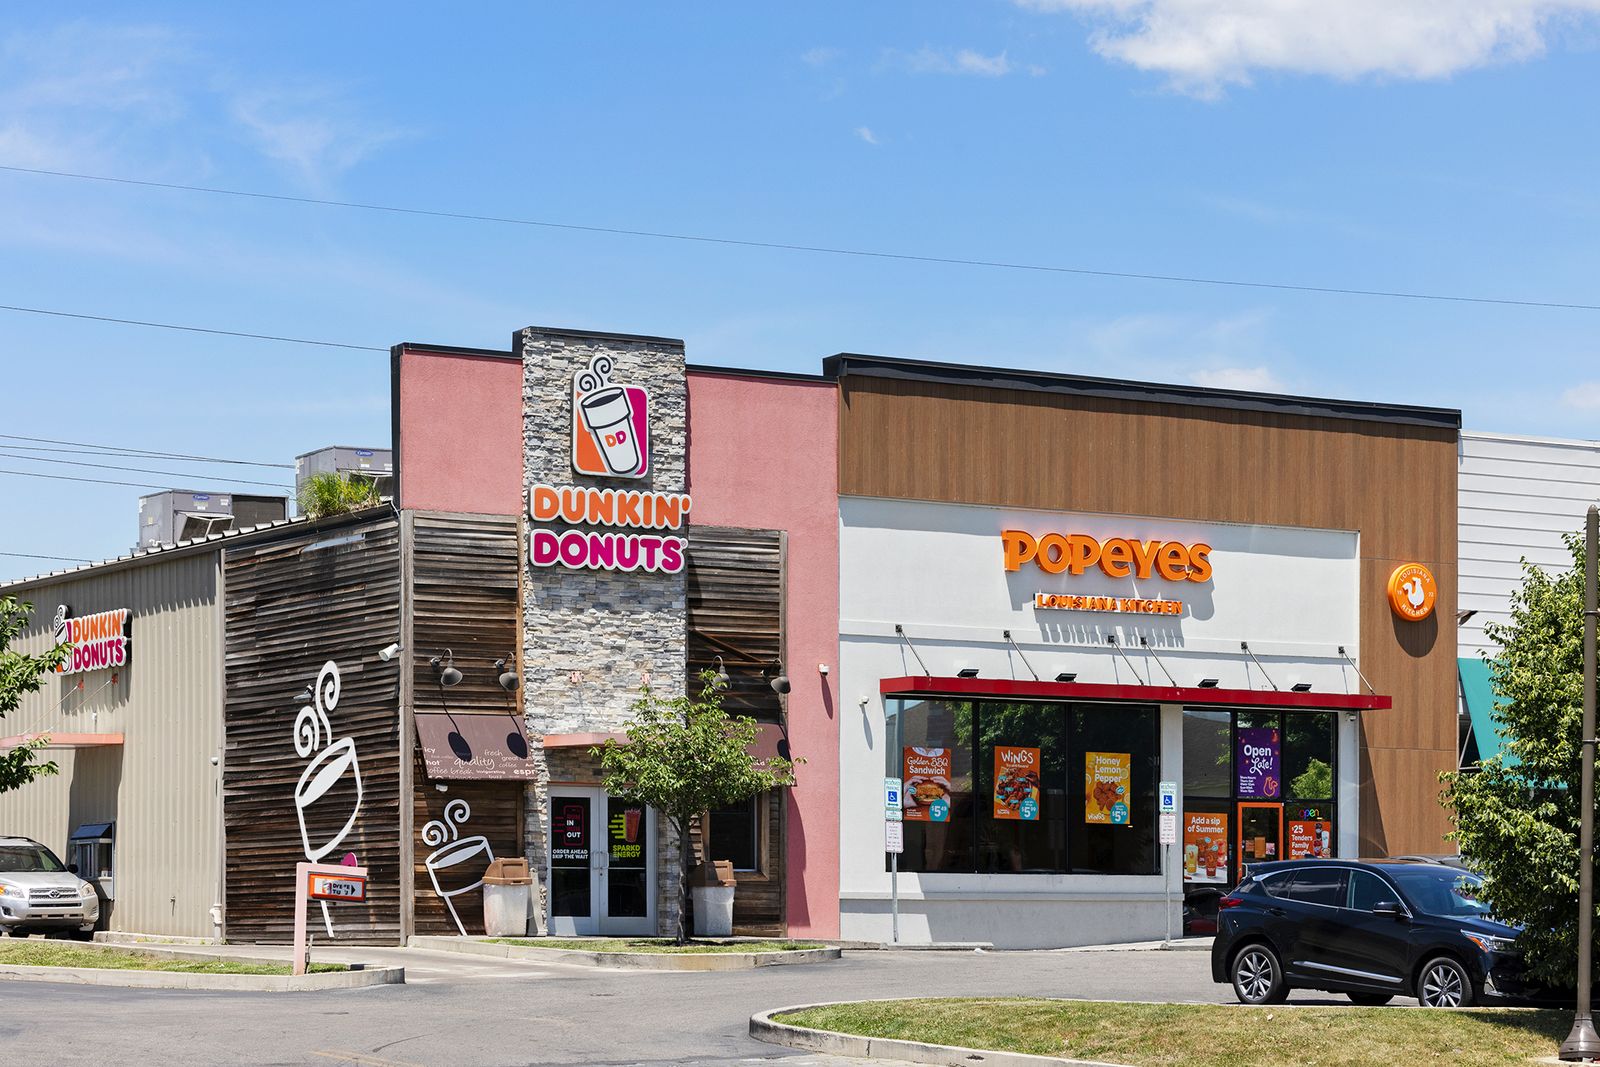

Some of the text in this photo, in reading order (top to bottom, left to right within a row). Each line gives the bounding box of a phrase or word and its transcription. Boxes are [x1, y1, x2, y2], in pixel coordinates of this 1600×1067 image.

[605, 430, 627, 447] DD
[534, 487, 690, 528] DUNKIN'
[533, 532, 682, 571] DONUTS
[1400, 568, 1431, 583] LOUISIANA
[1036, 594, 1183, 615] LOUISIANA KITCHEN
[1402, 603, 1429, 616] KITCHEN
[73, 610, 125, 643] DUNKIN'
[74, 638, 123, 670] DONUTS
[1244, 744, 1272, 758] Open
[454, 756, 495, 770] quality
[930, 757, 949, 768] BBQ
[1096, 756, 1121, 766] Honey
[1249, 757, 1273, 776] Late!
[909, 765, 946, 775] Sandwich
[1095, 765, 1121, 774] Lemon
[1095, 773, 1122, 783] Pepper
[1191, 816, 1205, 824] Add
[1210, 816, 1220, 826] sip
[1187, 825, 1224, 833] of Summer
[1292, 834, 1313, 842] Tenders
[1292, 841, 1310, 849] Family
